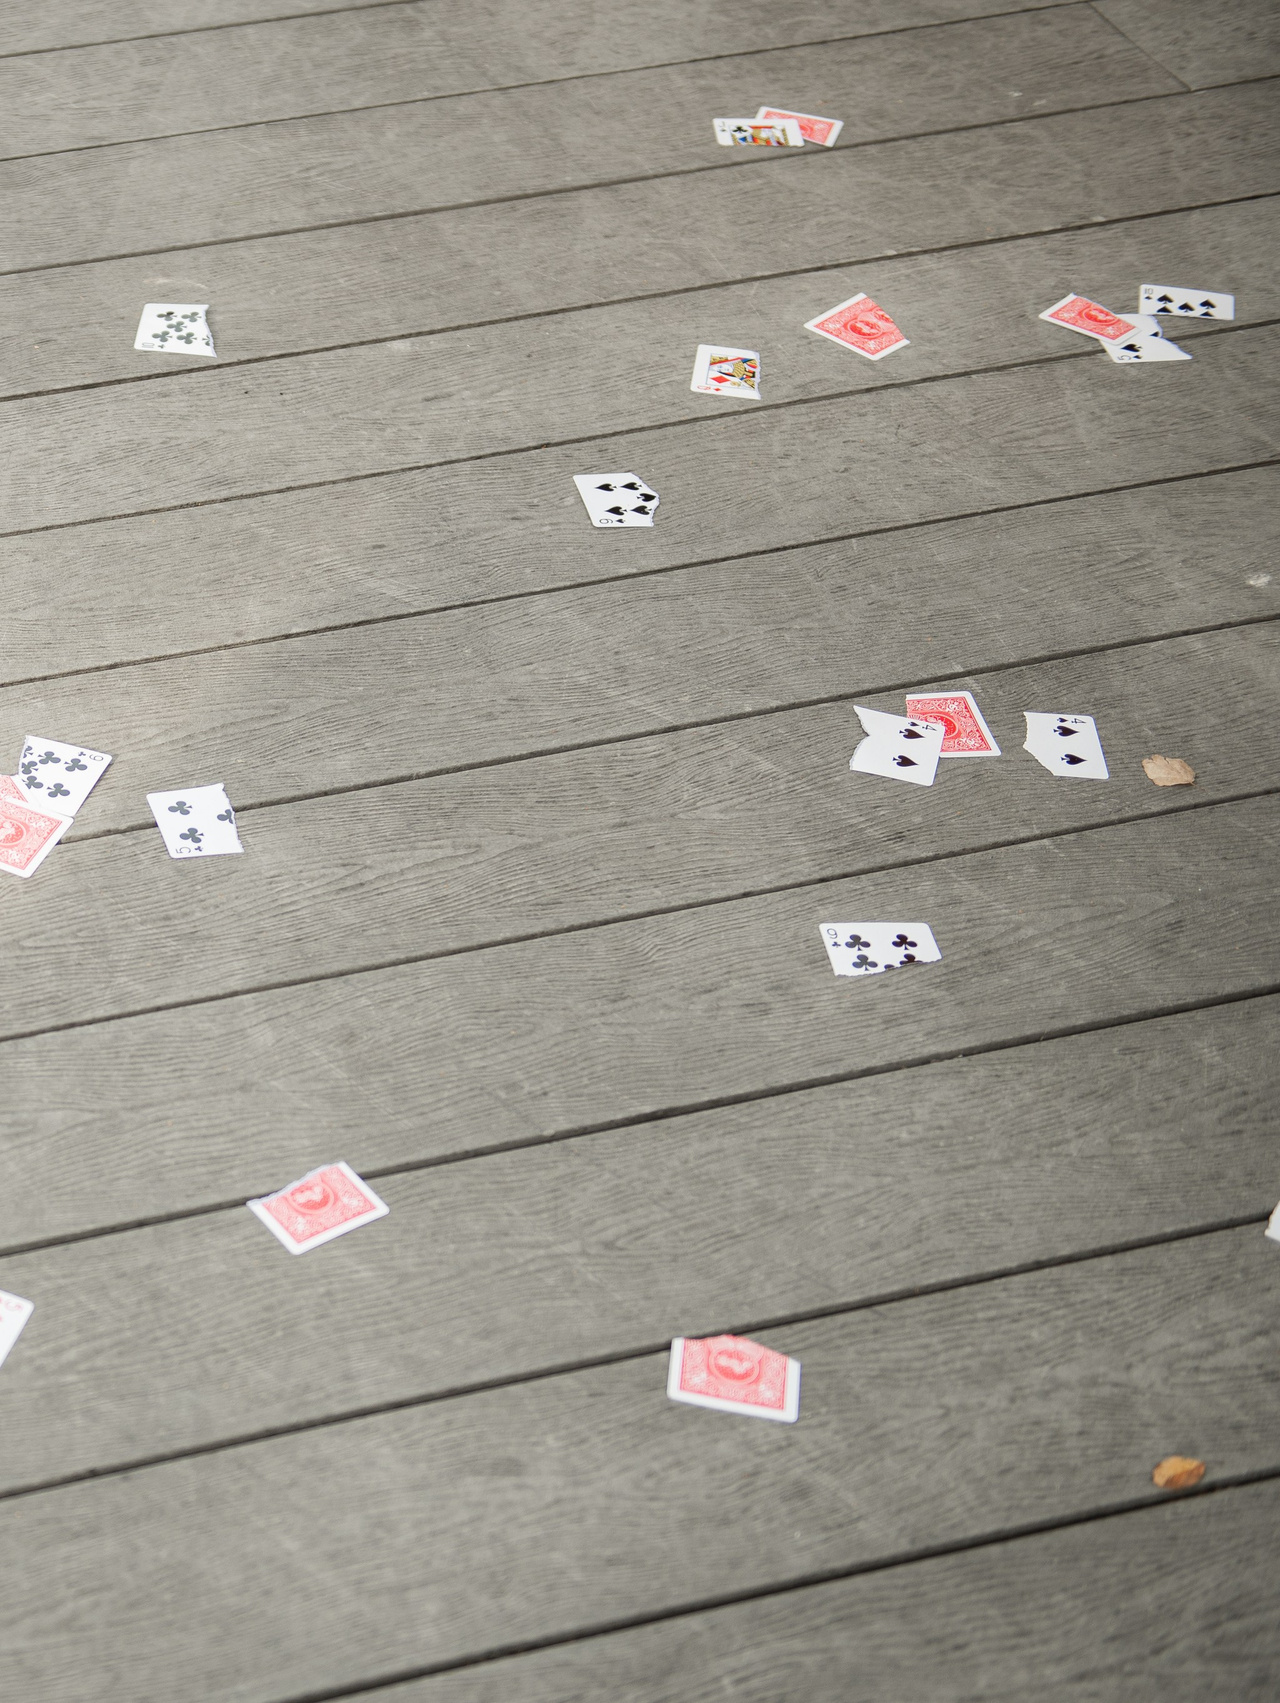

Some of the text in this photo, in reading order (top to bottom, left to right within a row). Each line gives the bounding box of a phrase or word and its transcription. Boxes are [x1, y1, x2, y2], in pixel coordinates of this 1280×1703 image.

[1144, 287, 1154, 295] 10
[921, 724, 937, 732] 4
[89, 753, 104, 762] 9
[175, 846, 191, 854] 5
[826, 928, 838, 939] 9
